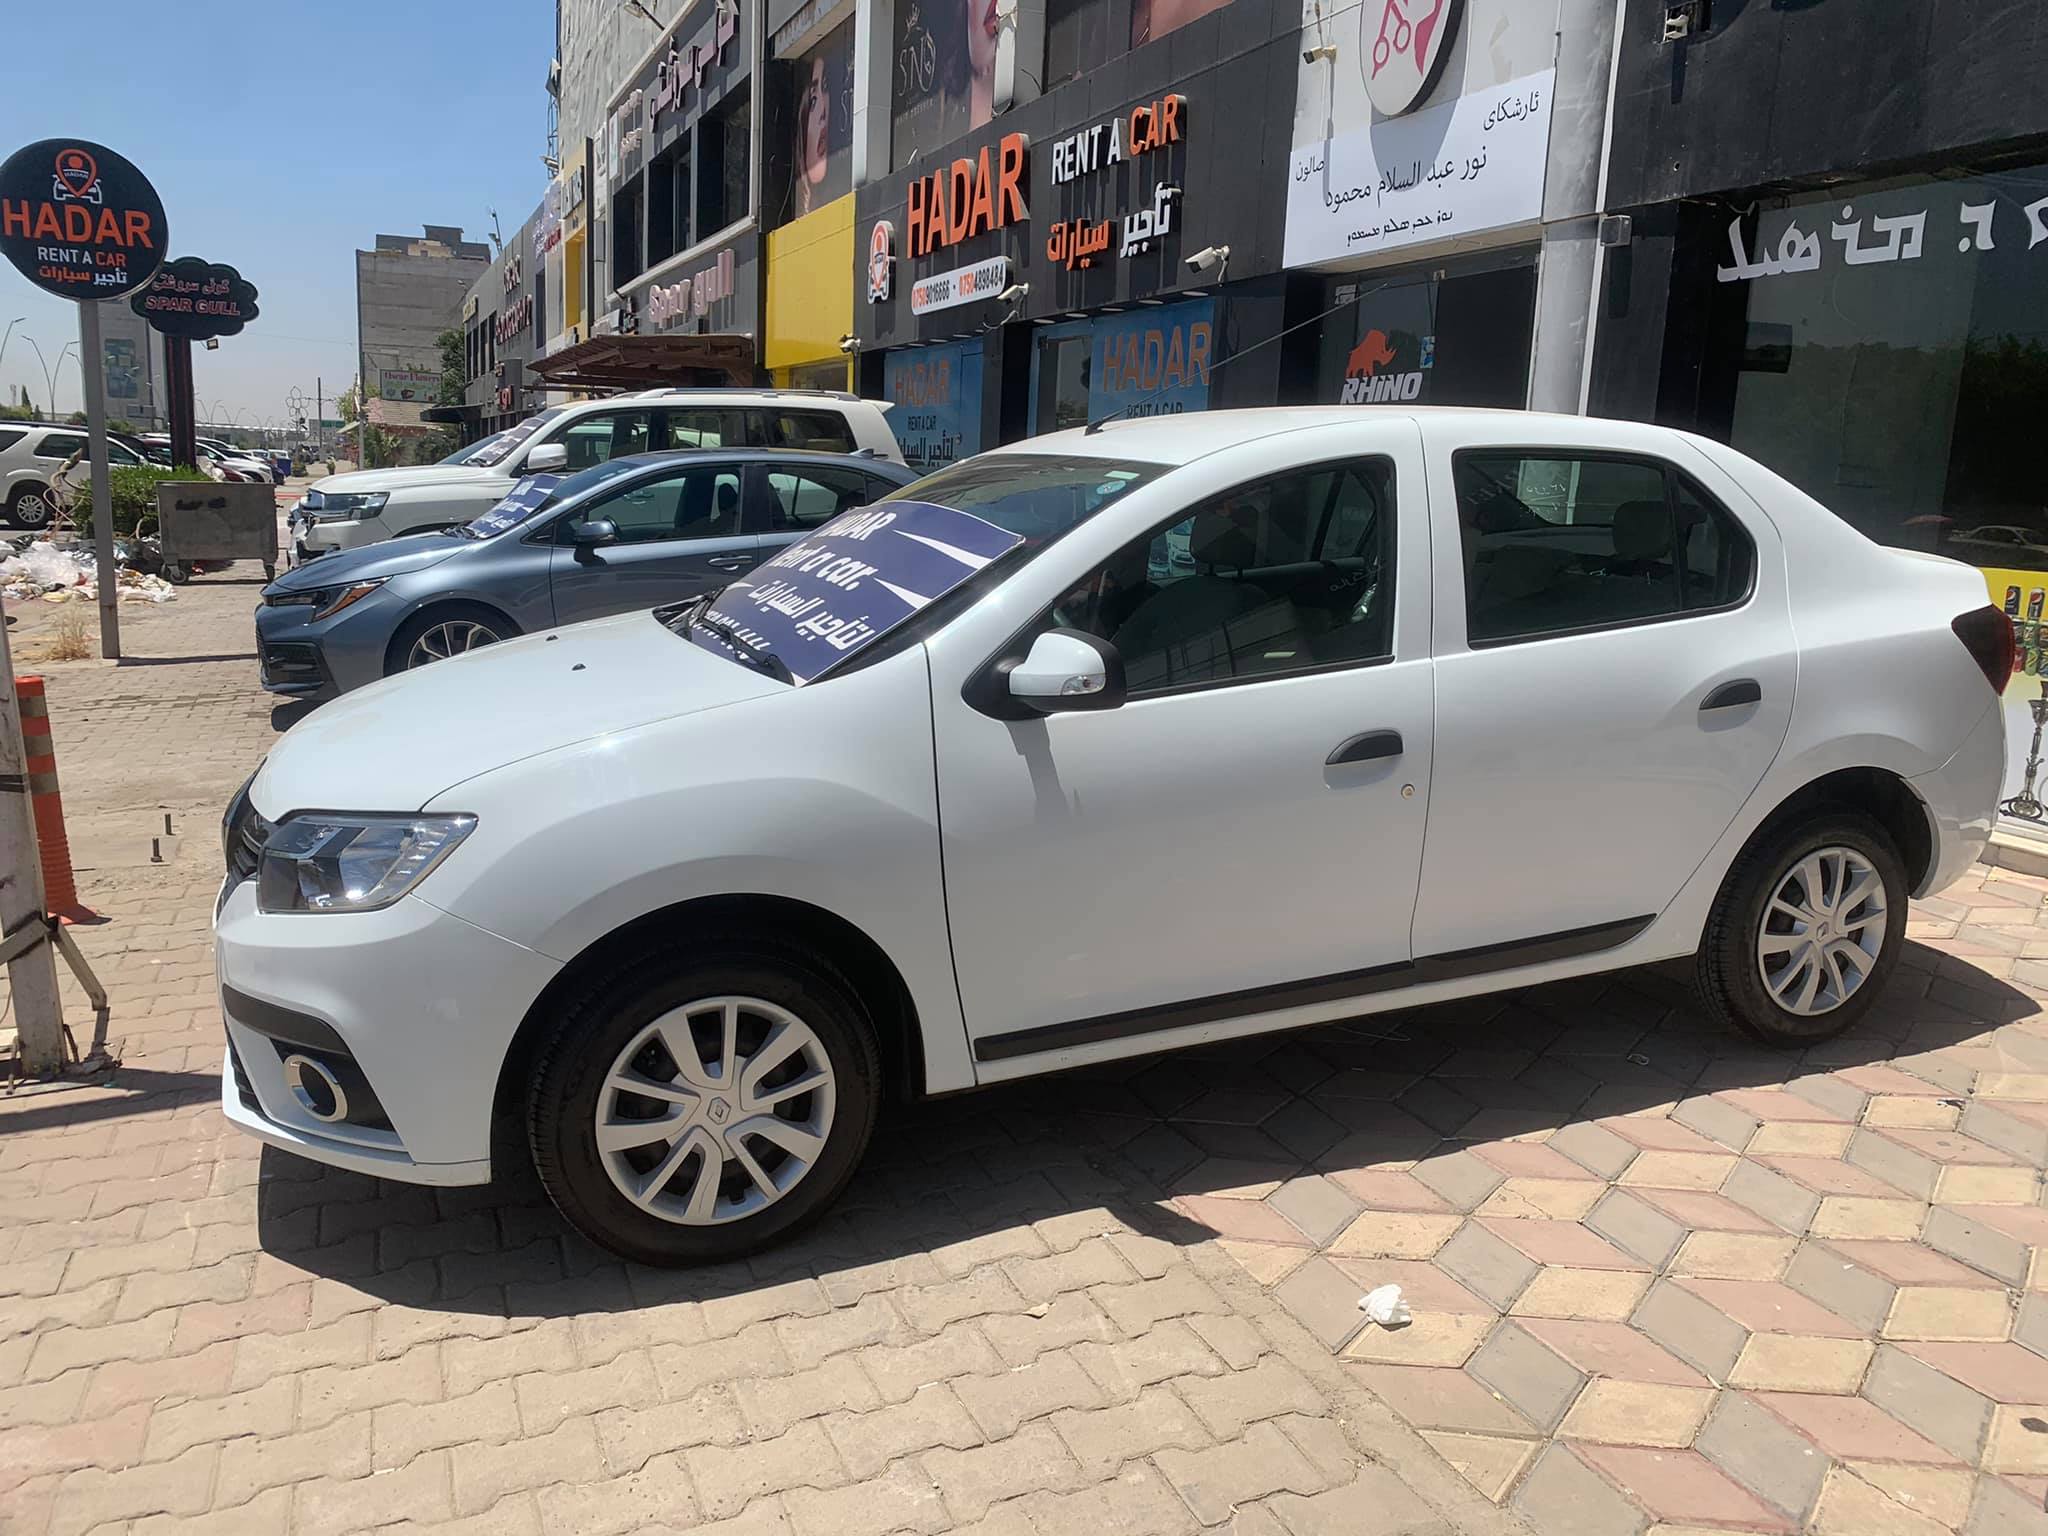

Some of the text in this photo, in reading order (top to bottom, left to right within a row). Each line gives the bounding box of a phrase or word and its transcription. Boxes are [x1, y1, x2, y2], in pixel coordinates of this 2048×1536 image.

[1051, 94, 1182, 185] RENT A CAR
[1296, 156, 1325, 181] صالون
[1326, 145, 1487, 213] نور عبد السلام محمود
[907, 133, 1026, 259] HADAR
[2, 198, 153, 249] HADAR
[1047, 182, 1174, 271] تأجير سيارات
[38, 247, 127, 267] RENT A CAR
[39, 266, 127, 286] تأجير سيارات
[145, 295, 240, 316] SPAR GULL
[649, 249, 735, 328] Spar gull
[1104, 322, 1211, 393] HADAR
[896, 359, 950, 407] HADAR
[1341, 372, 1424, 405] RHINO
[747, 579, 825, 618] السيارات
[795, 615, 876, 651] لتأجير
